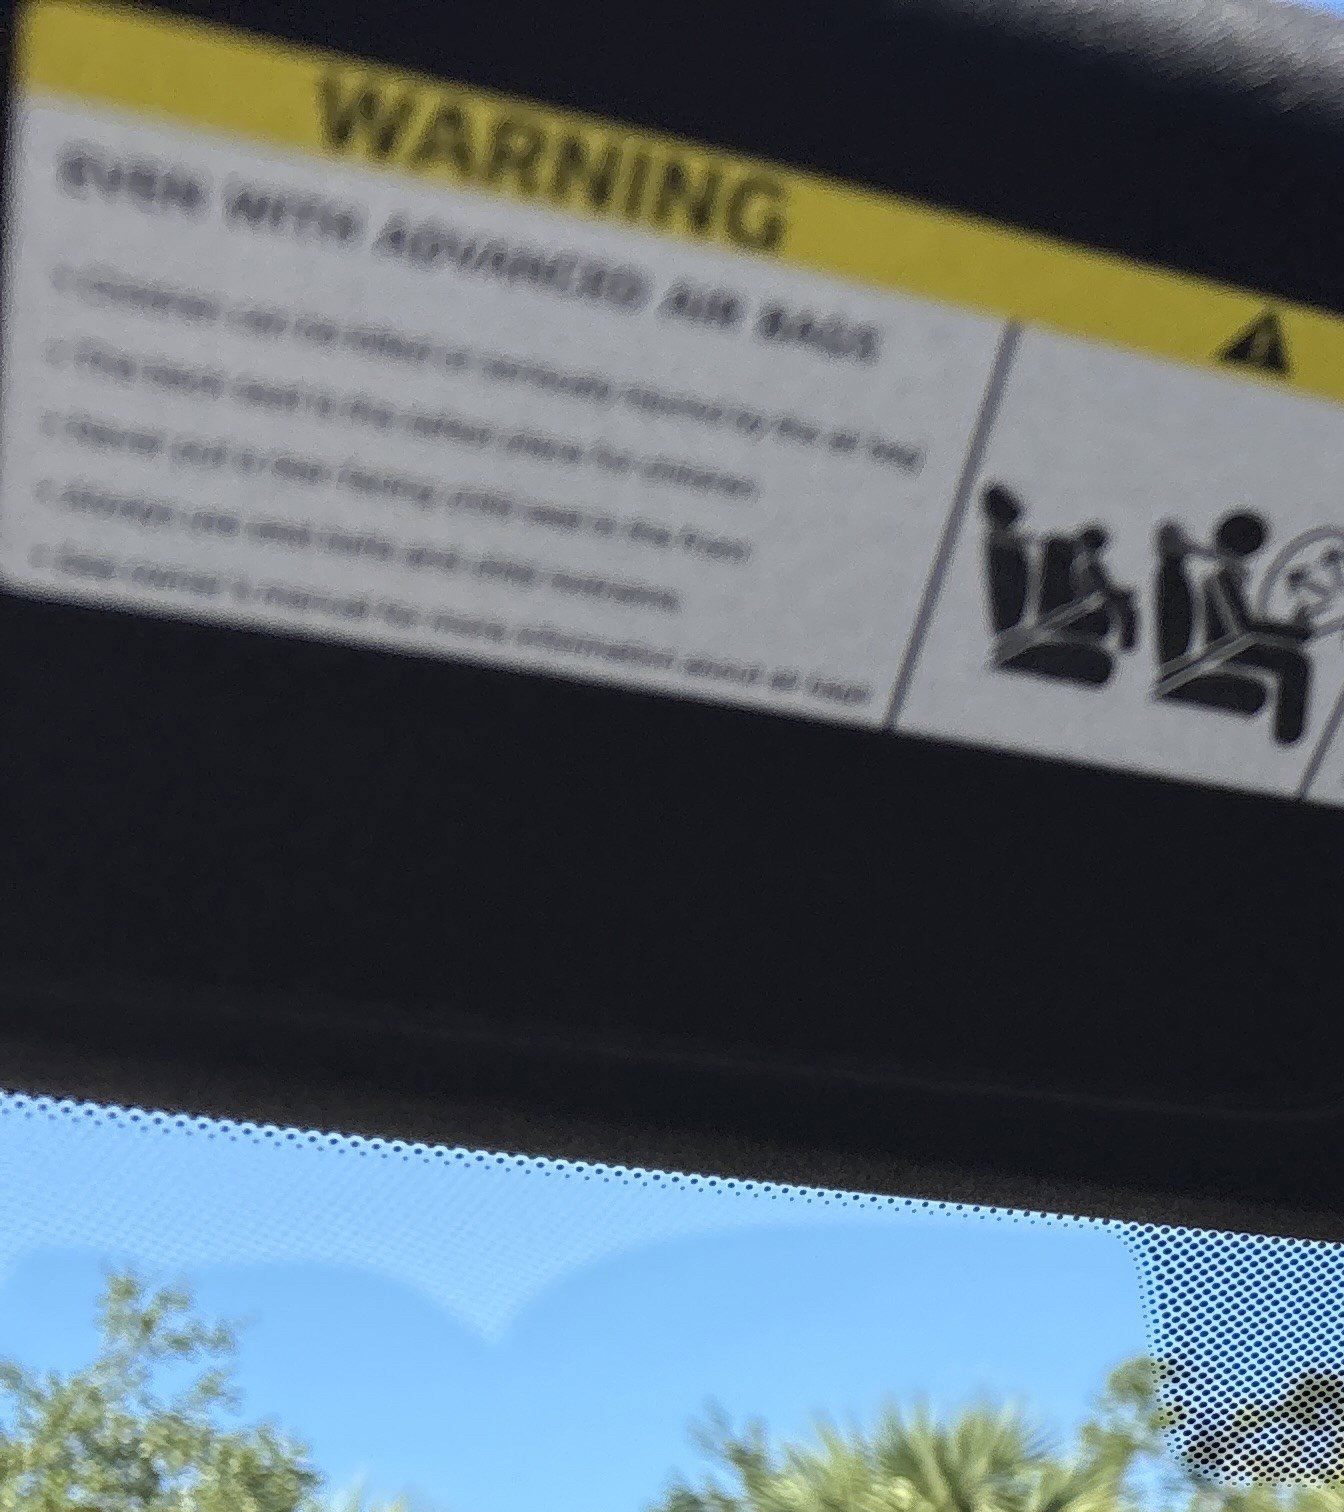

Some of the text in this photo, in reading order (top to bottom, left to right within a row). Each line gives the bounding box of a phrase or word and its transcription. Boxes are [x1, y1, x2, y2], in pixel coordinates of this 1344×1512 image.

[57, 135, 886, 366] EVEN WITH ADVANCED AIR BAGS
[315, 68, 788, 252] WARNING
